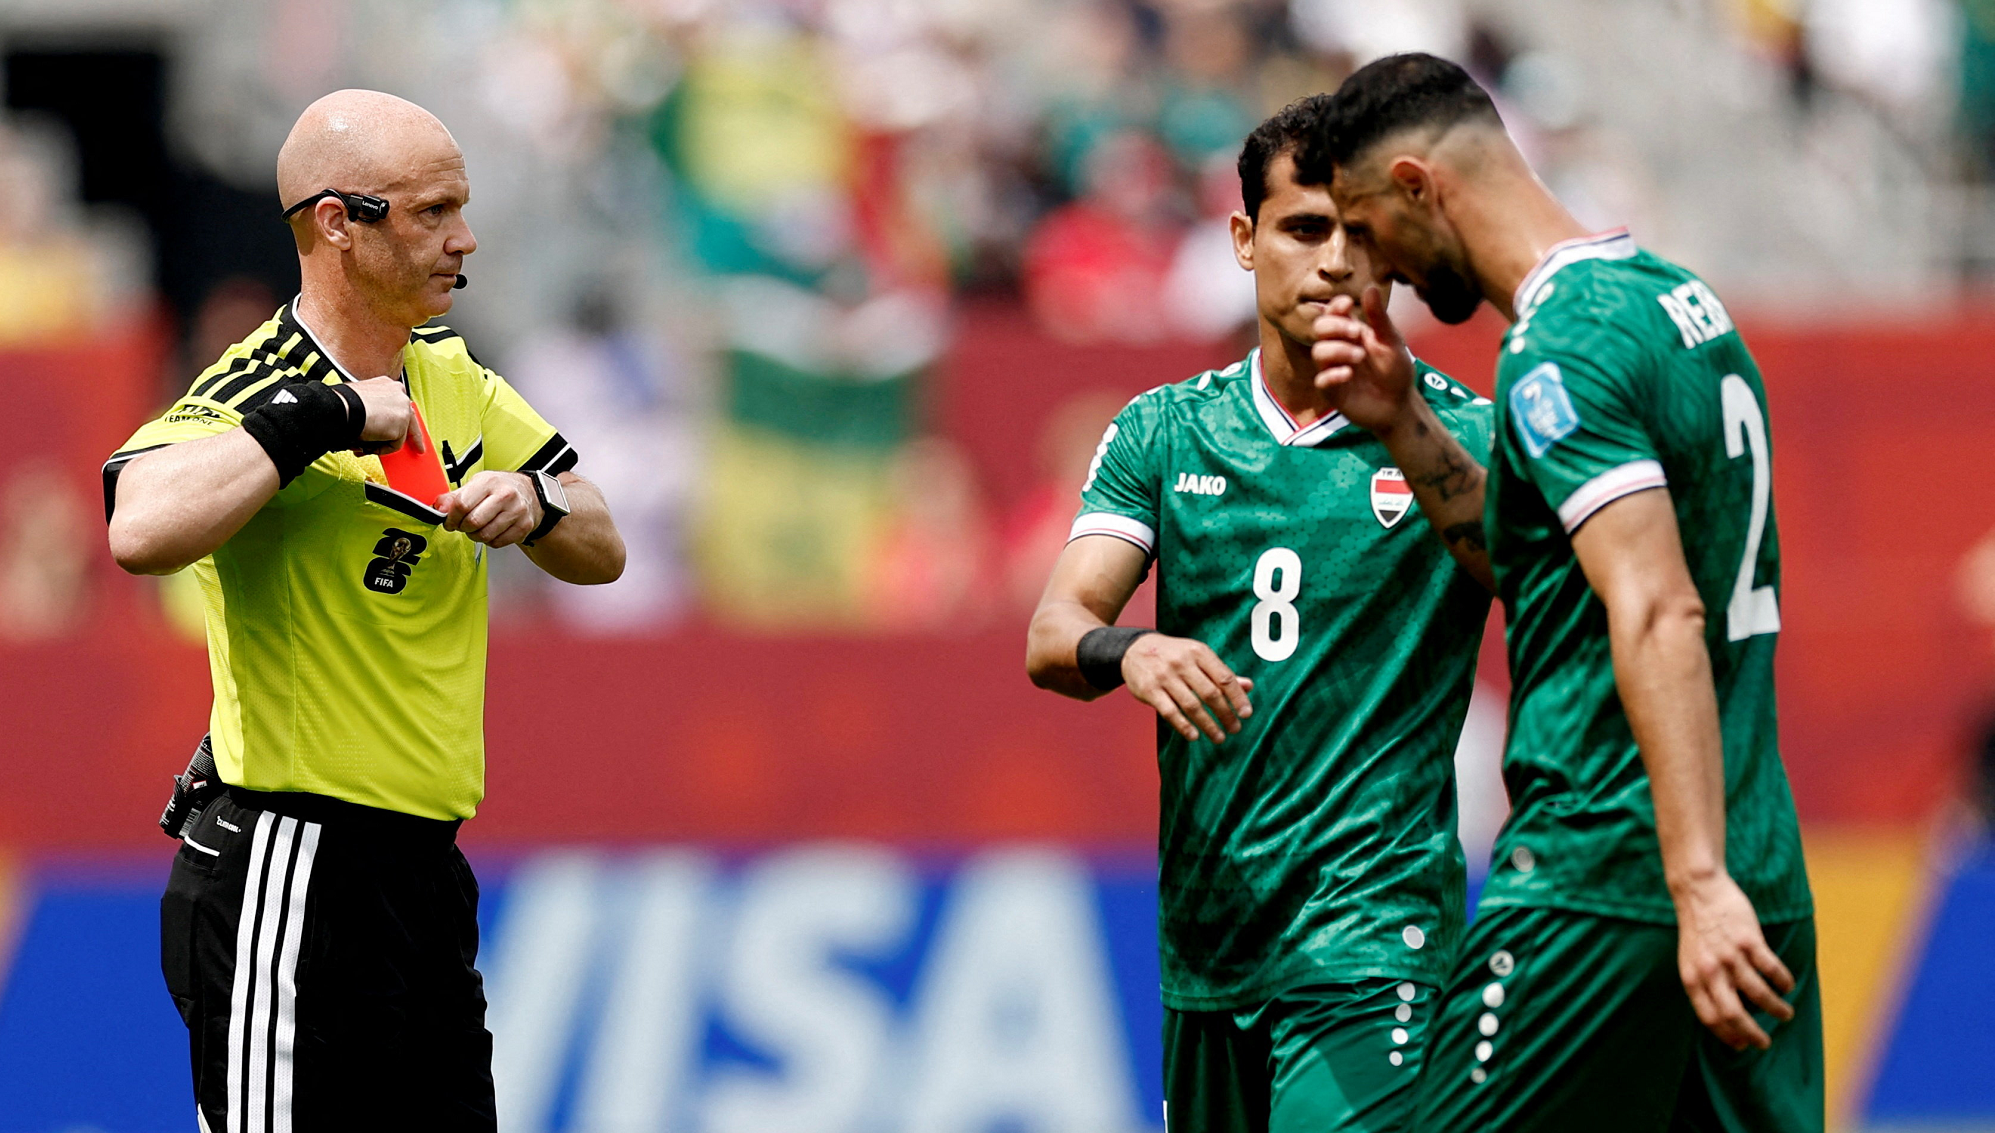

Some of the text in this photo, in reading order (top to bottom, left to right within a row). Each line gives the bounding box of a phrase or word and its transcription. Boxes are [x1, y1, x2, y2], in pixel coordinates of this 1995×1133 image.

[362, 200, 379, 210] Lenovo
[1174, 472, 1227, 496] JAKO
[1720, 373, 1781, 642] 2
[374, 577, 394, 588] FIFA
[1251, 547, 1302, 662] 8
